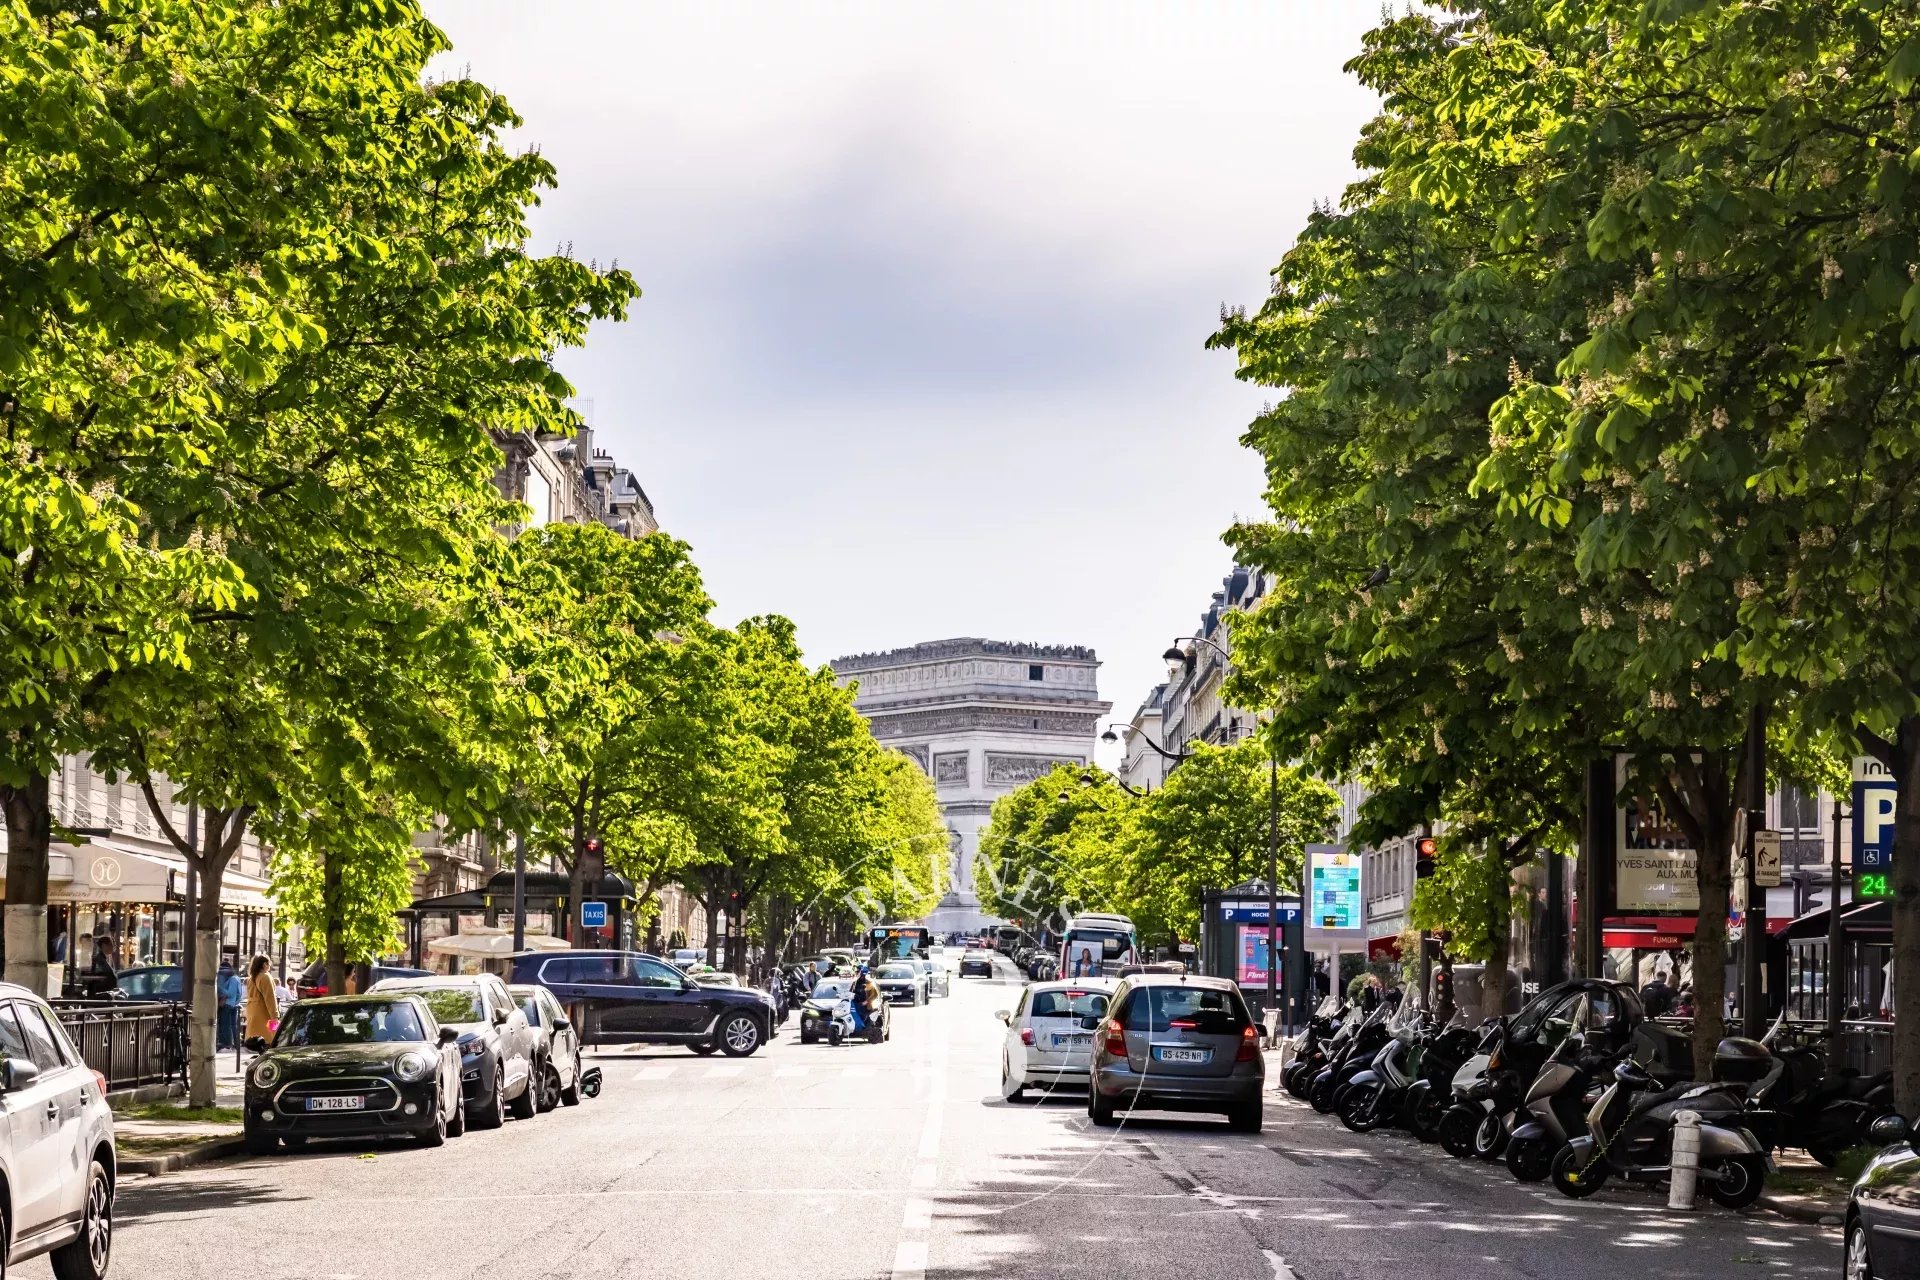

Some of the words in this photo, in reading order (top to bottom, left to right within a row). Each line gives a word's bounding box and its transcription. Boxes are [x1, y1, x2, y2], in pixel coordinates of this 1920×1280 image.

[1863, 788, 1898, 844] P
[1617, 860, 1643, 869] YVES
[1644, 860, 1674, 869] SAINT
[1656, 870, 1678, 879] AUX
[1680, 870, 1697, 879] MU
[584, 911, 604, 919] TAXIS
[1225, 909, 1234, 920] P
[1287, 910, 1296, 921] P
[1652, 936, 1678, 944] FUMOIR
[1246, 971, 1266, 979] Flink
[312, 1098, 357, 1109] DW-128-LS
